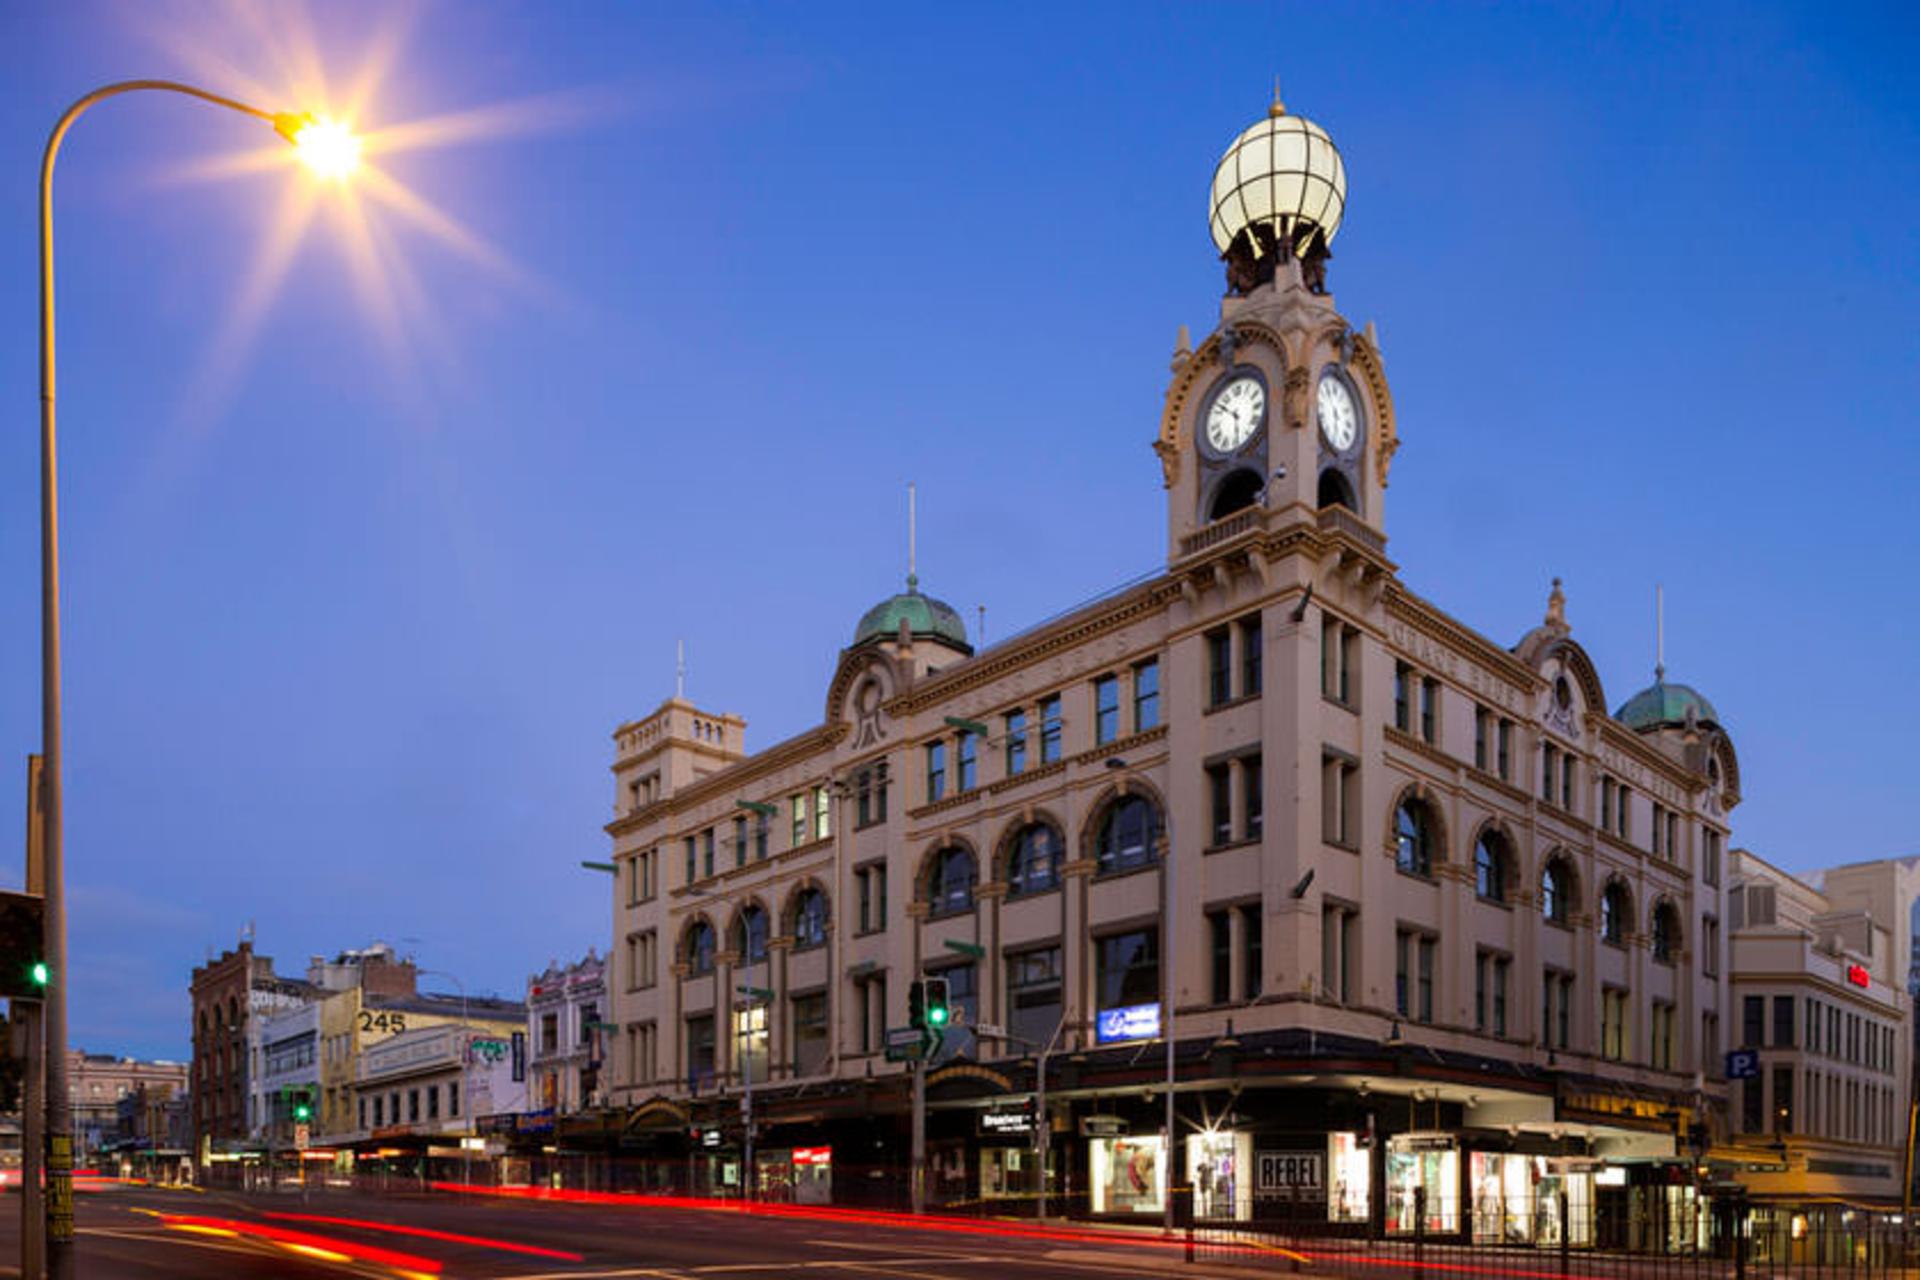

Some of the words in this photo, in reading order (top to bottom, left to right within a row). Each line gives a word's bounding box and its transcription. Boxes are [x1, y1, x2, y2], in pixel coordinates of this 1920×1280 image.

[358, 1011, 405, 1034] 245
[1733, 1055, 1750, 1075] P
[1262, 1158, 1318, 1187] REBEL
